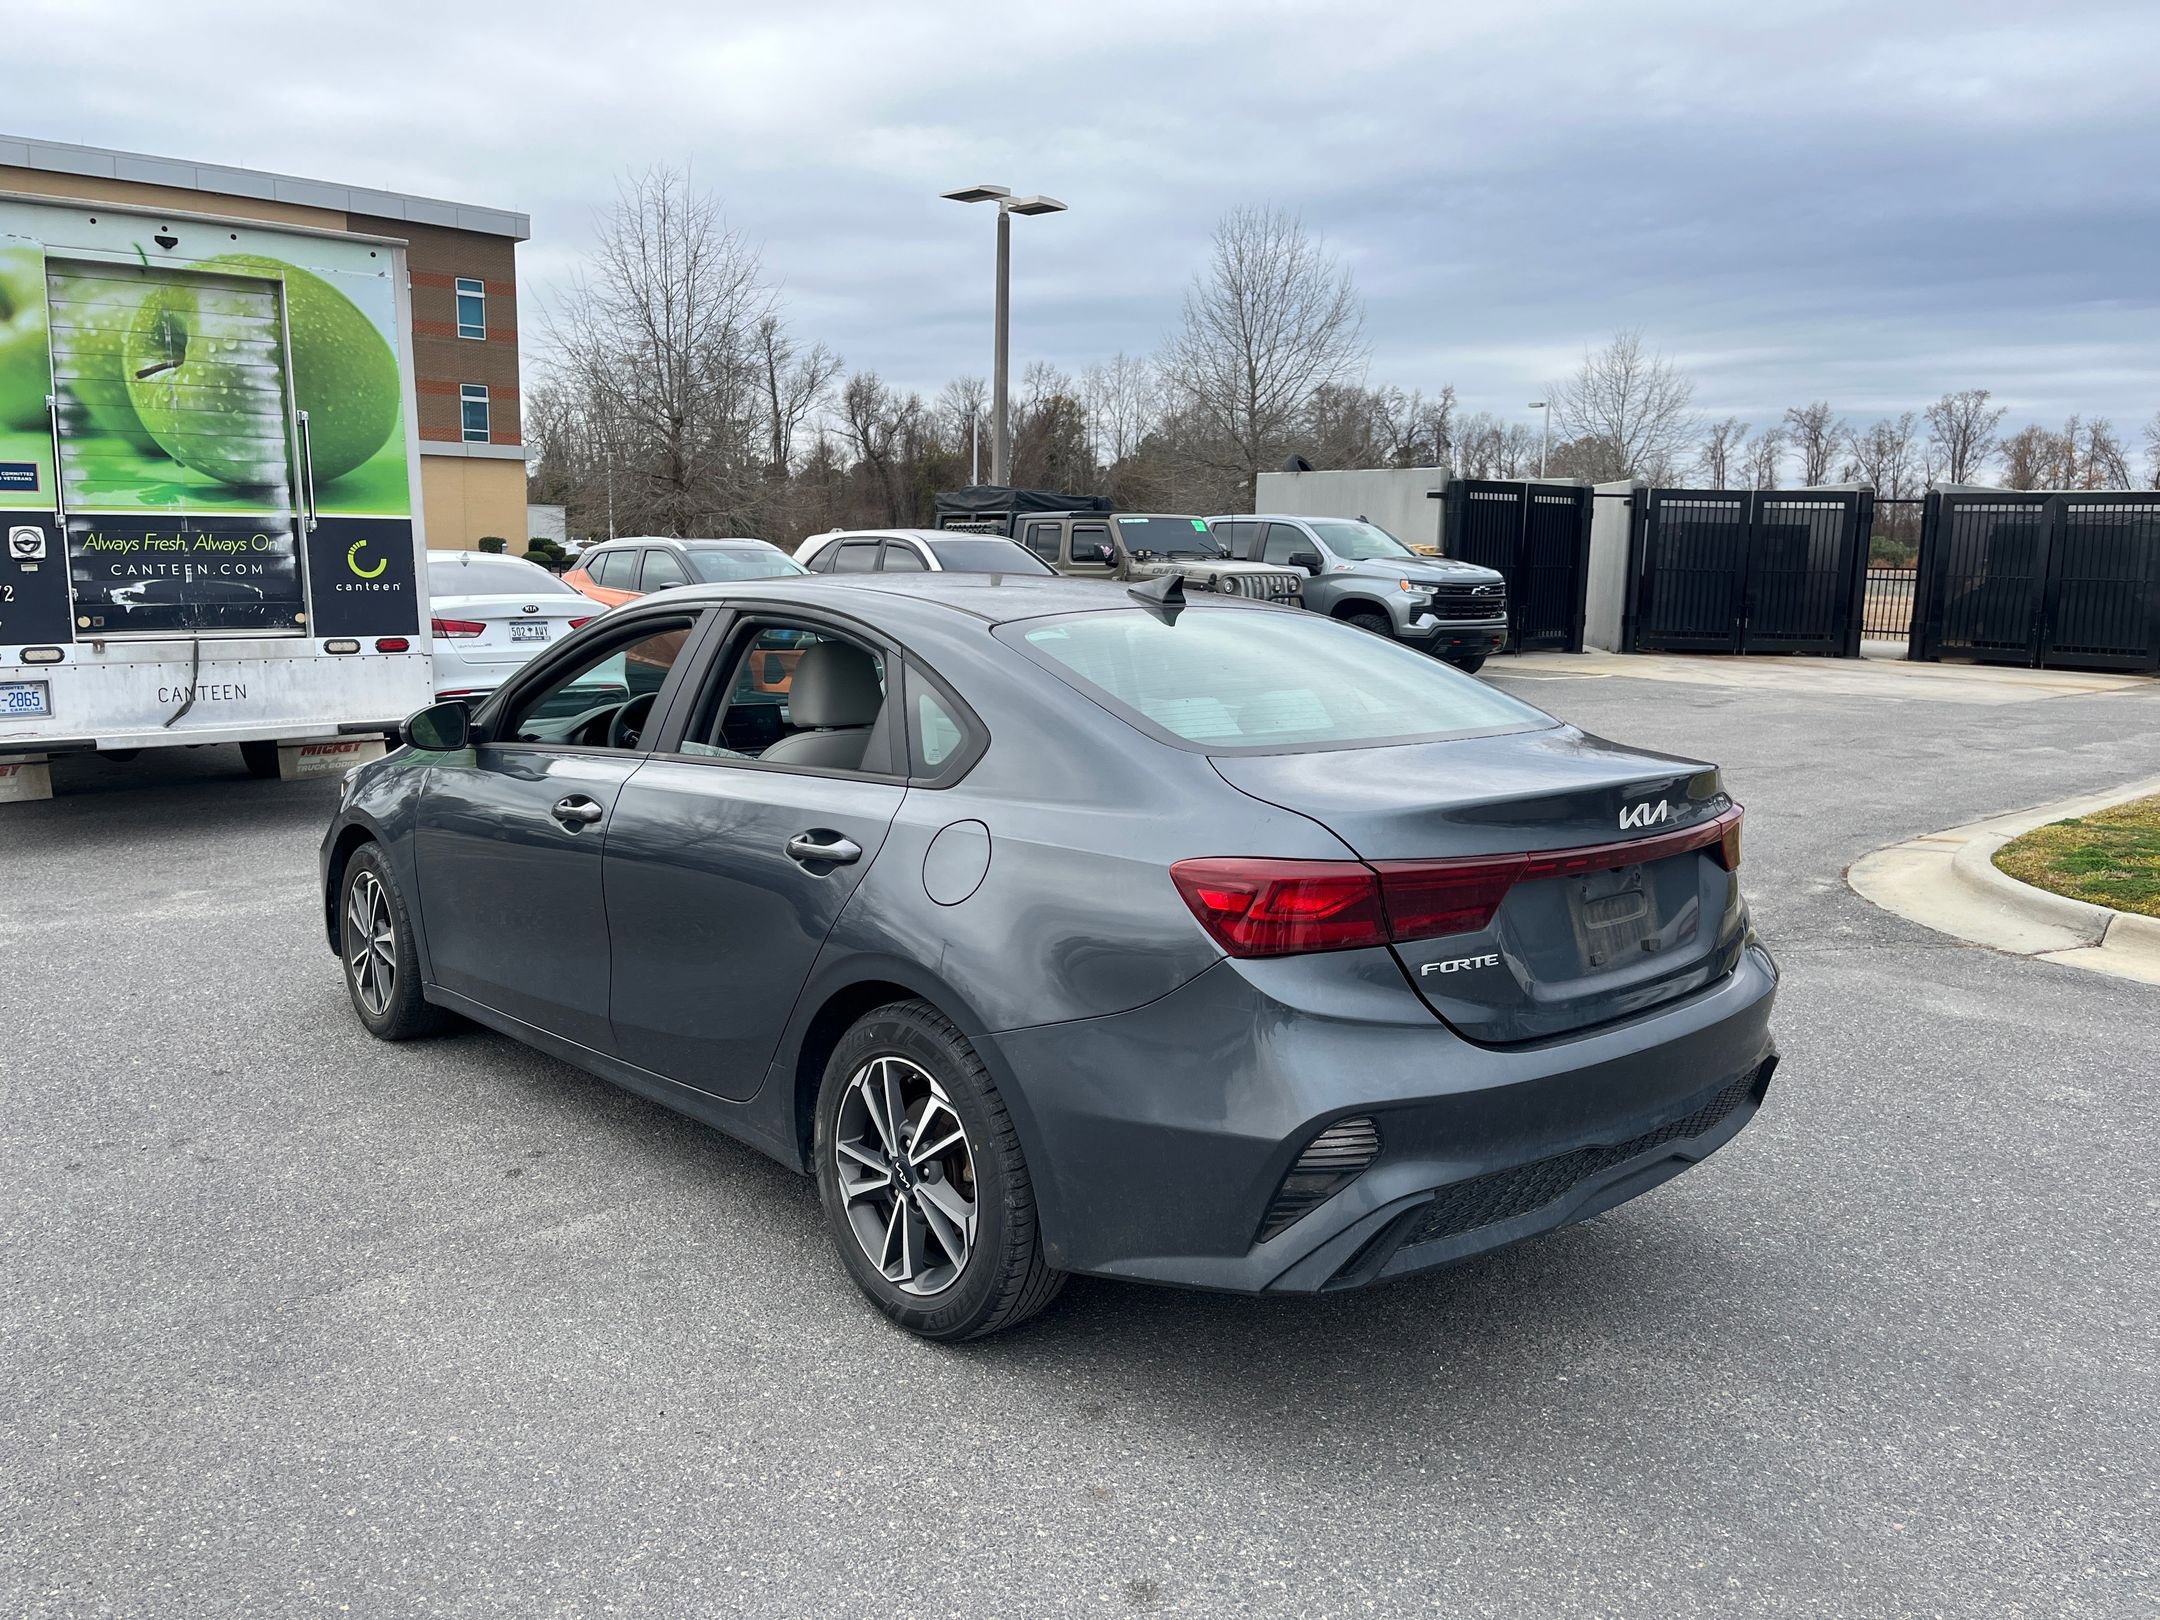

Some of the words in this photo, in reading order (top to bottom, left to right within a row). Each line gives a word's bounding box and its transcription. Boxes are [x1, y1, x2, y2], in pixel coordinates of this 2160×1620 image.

[83, 533, 139, 555] Always
[143, 533, 189, 552] Fresh,
[193, 533, 247, 555] Always
[110, 563, 264, 576] CANTEEN.COM
[335, 582, 400, 591] canteen
[511, 626, 525, 636] 502
[158, 684, 247, 703] CANTEEN
[301, 742, 361, 755] MICKEY
[297, 763, 326, 773] TRUCK
[1619, 799, 1668, 830] KIA
[1420, 953, 1499, 977] FORTE
